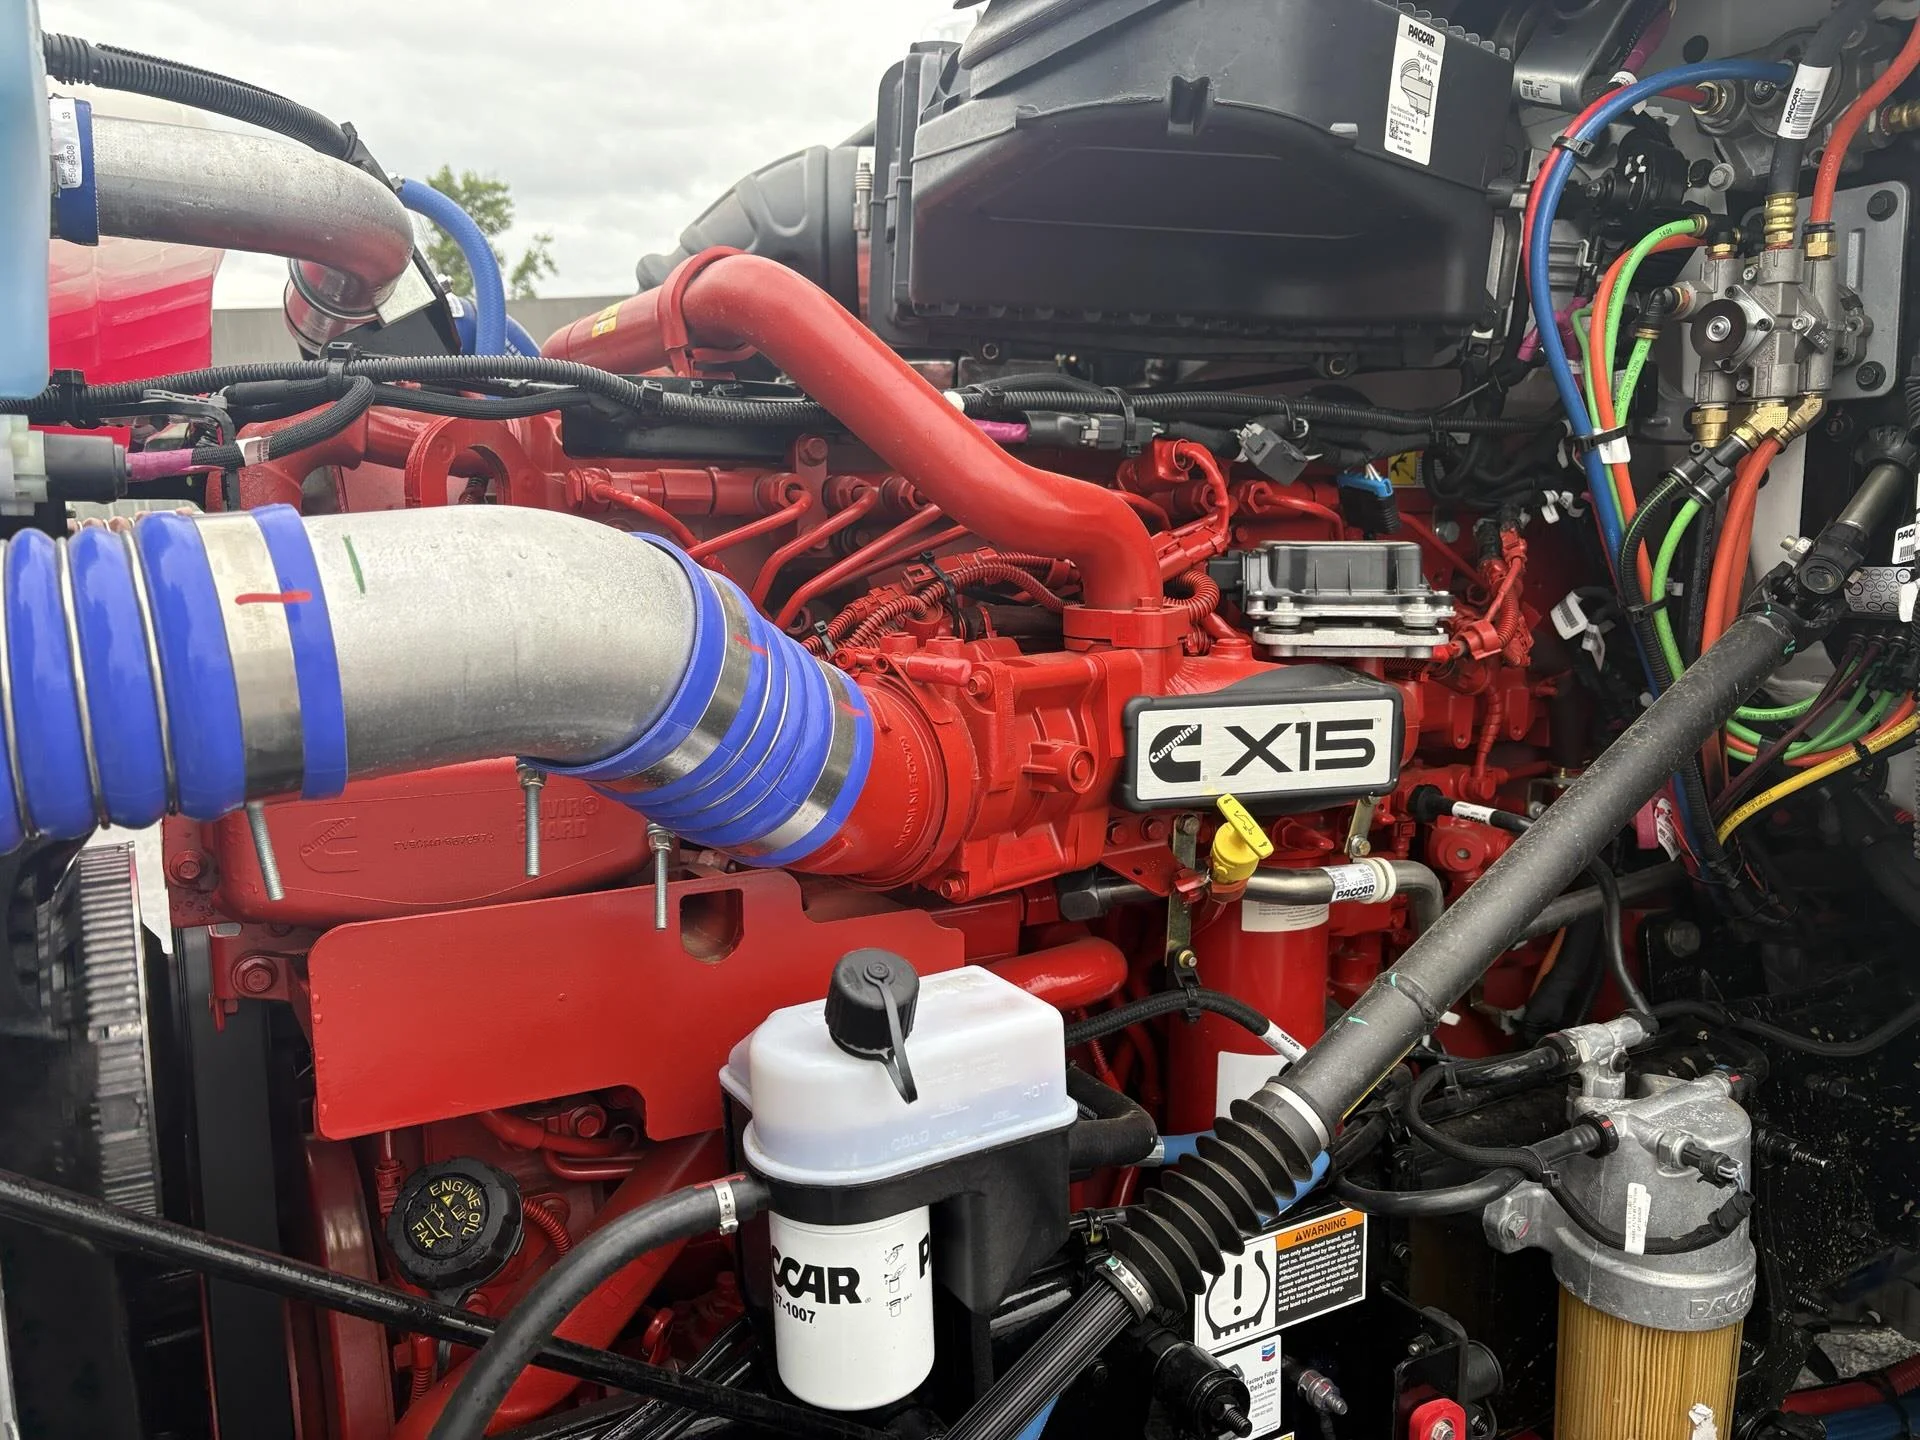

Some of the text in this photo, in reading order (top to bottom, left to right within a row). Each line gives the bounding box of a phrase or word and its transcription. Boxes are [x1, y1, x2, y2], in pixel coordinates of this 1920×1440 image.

[1408, 23, 1436, 48] PACCAR
[1785, 87, 1802, 124] PACCAR
[1149, 723, 1200, 764] Cummins
[1221, 719, 1375, 777] X15
[1336, 884, 1375, 899] PACCAR
[429, 1179, 481, 1236] ENGINE OIL
[411, 1221, 436, 1249] FA4
[1302, 1217, 1347, 1239] WARNING
[918, 1231, 931, 1280] P
[1279, 1260, 1289, 1269] part
[1300, 1249, 1320, 1262] installed
[1328, 1244, 1336, 1252] the
[1337, 1237, 1355, 1250] original
[1279, 1261, 1305, 1276] equipment
[1306, 1250, 1339, 1267] manufacturer.
[1341, 1247, 1349, 1255] Use
[1280, 1252, 1289, 1261] Use
[1291, 1249, 1301, 1258] only
[1311, 1240, 1325, 1251] wheel
[1326, 1235, 1341, 1246] brand,
[1342, 1231, 1351, 1240] size
[1279, 1270, 1299, 1283] different
[1301, 1265, 1314, 1276] wheel
[1316, 1260, 1330, 1270] brand
[1338, 1255, 1346, 1263] size
[1348, 1250, 1360, 1260] could
[1279, 1280, 1293, 1290] cause
[1295, 1275, 1307, 1285] valve
[1309, 1271, 1320, 1280] stem
[1328, 1261, 1347, 1274] interfere
[1349, 1258, 1358, 1267] with
[1283, 1286, 1297, 1296] brake
[1298, 1276, 1325, 1291] component
[1326, 1271, 1340, 1281] which
[1341, 1265, 1354, 1276] could
[1279, 1296, 1289, 1305] lead
[1296, 1290, 1306, 1299] loss
[1314, 1281, 1330, 1293] vehicle
[1332, 1275, 1348, 1286] control
[1350, 1272, 1358, 1280] and
[1279, 1304, 1288, 1313] may
[1290, 1299, 1300, 1309] lead
[1308, 1290, 1328, 1303] personal
[1330, 1284, 1344, 1296] injury.
